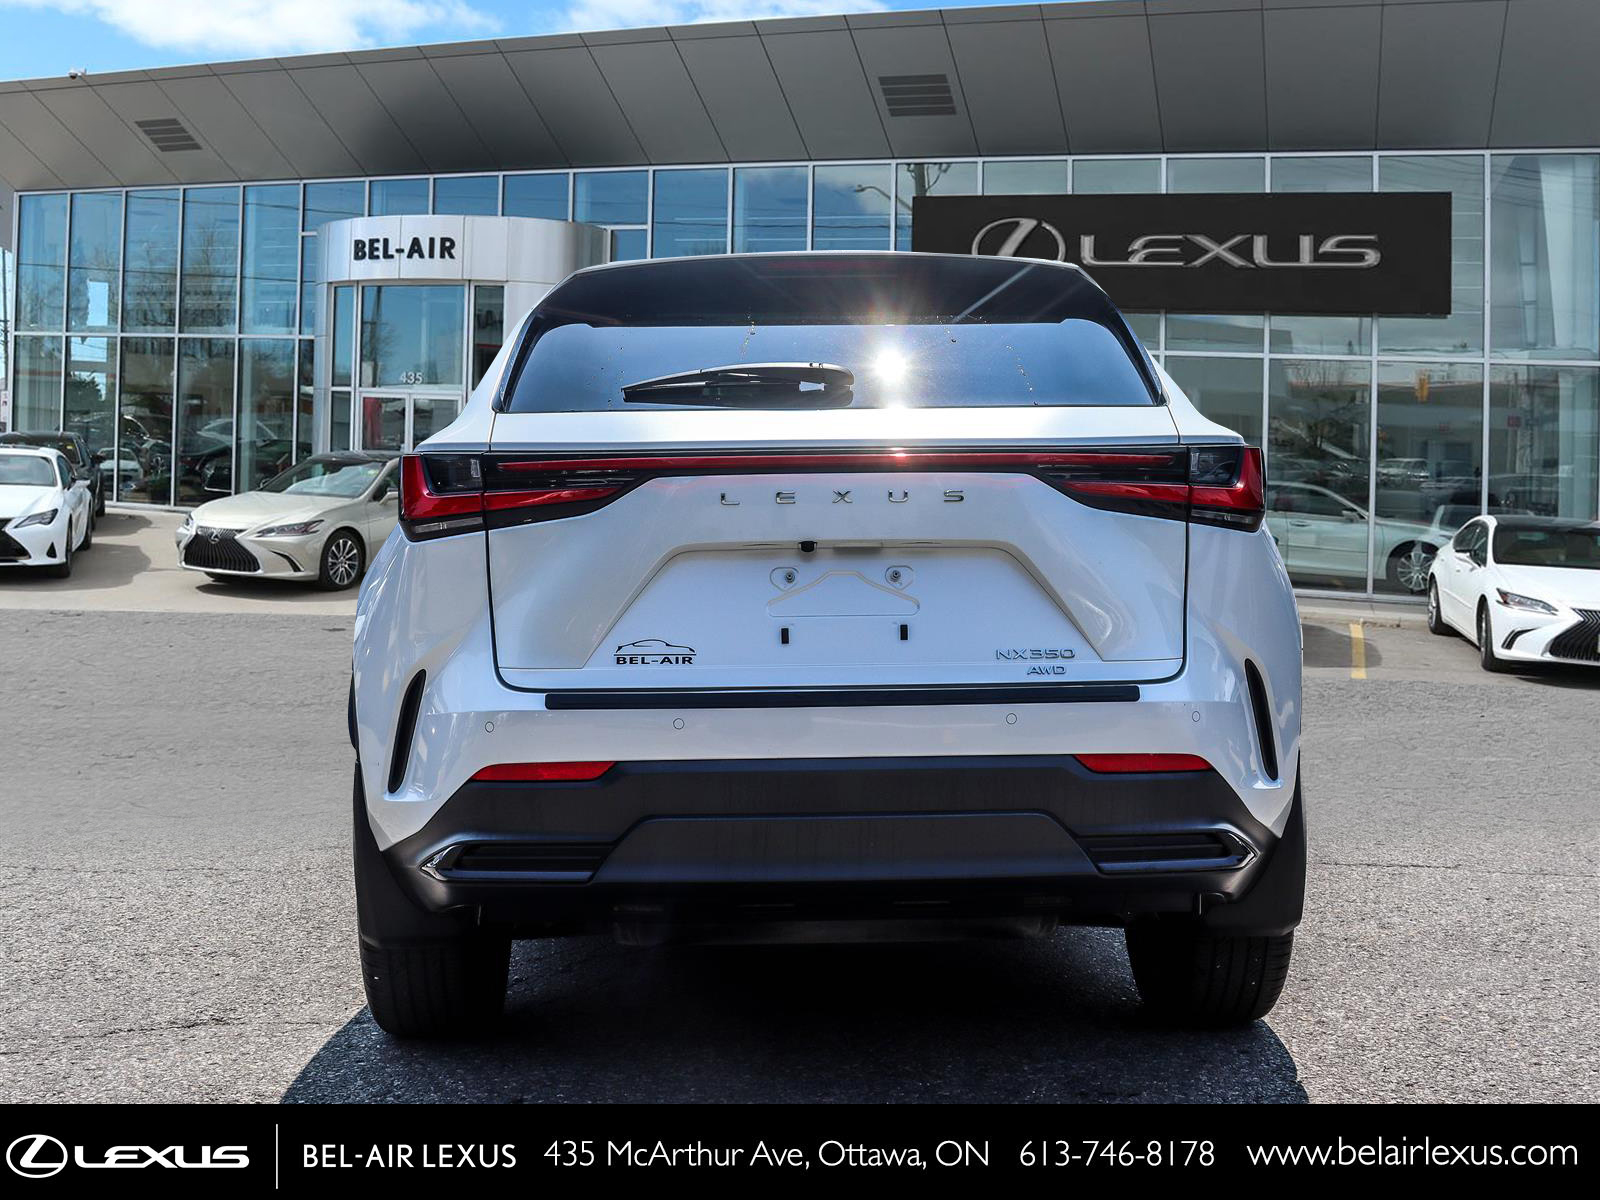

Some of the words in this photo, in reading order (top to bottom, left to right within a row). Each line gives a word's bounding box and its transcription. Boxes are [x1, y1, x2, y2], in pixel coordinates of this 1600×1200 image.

[353, 236, 457, 261] BEL-AIR
[1080, 234, 1382, 269] LEXUS
[399, 371, 424, 385] 435
[719, 489, 966, 506] LEXUS
[616, 656, 694, 665] BEL-AIR
[995, 648, 1077, 660] NX350
[1026, 665, 1067, 676] AWD
